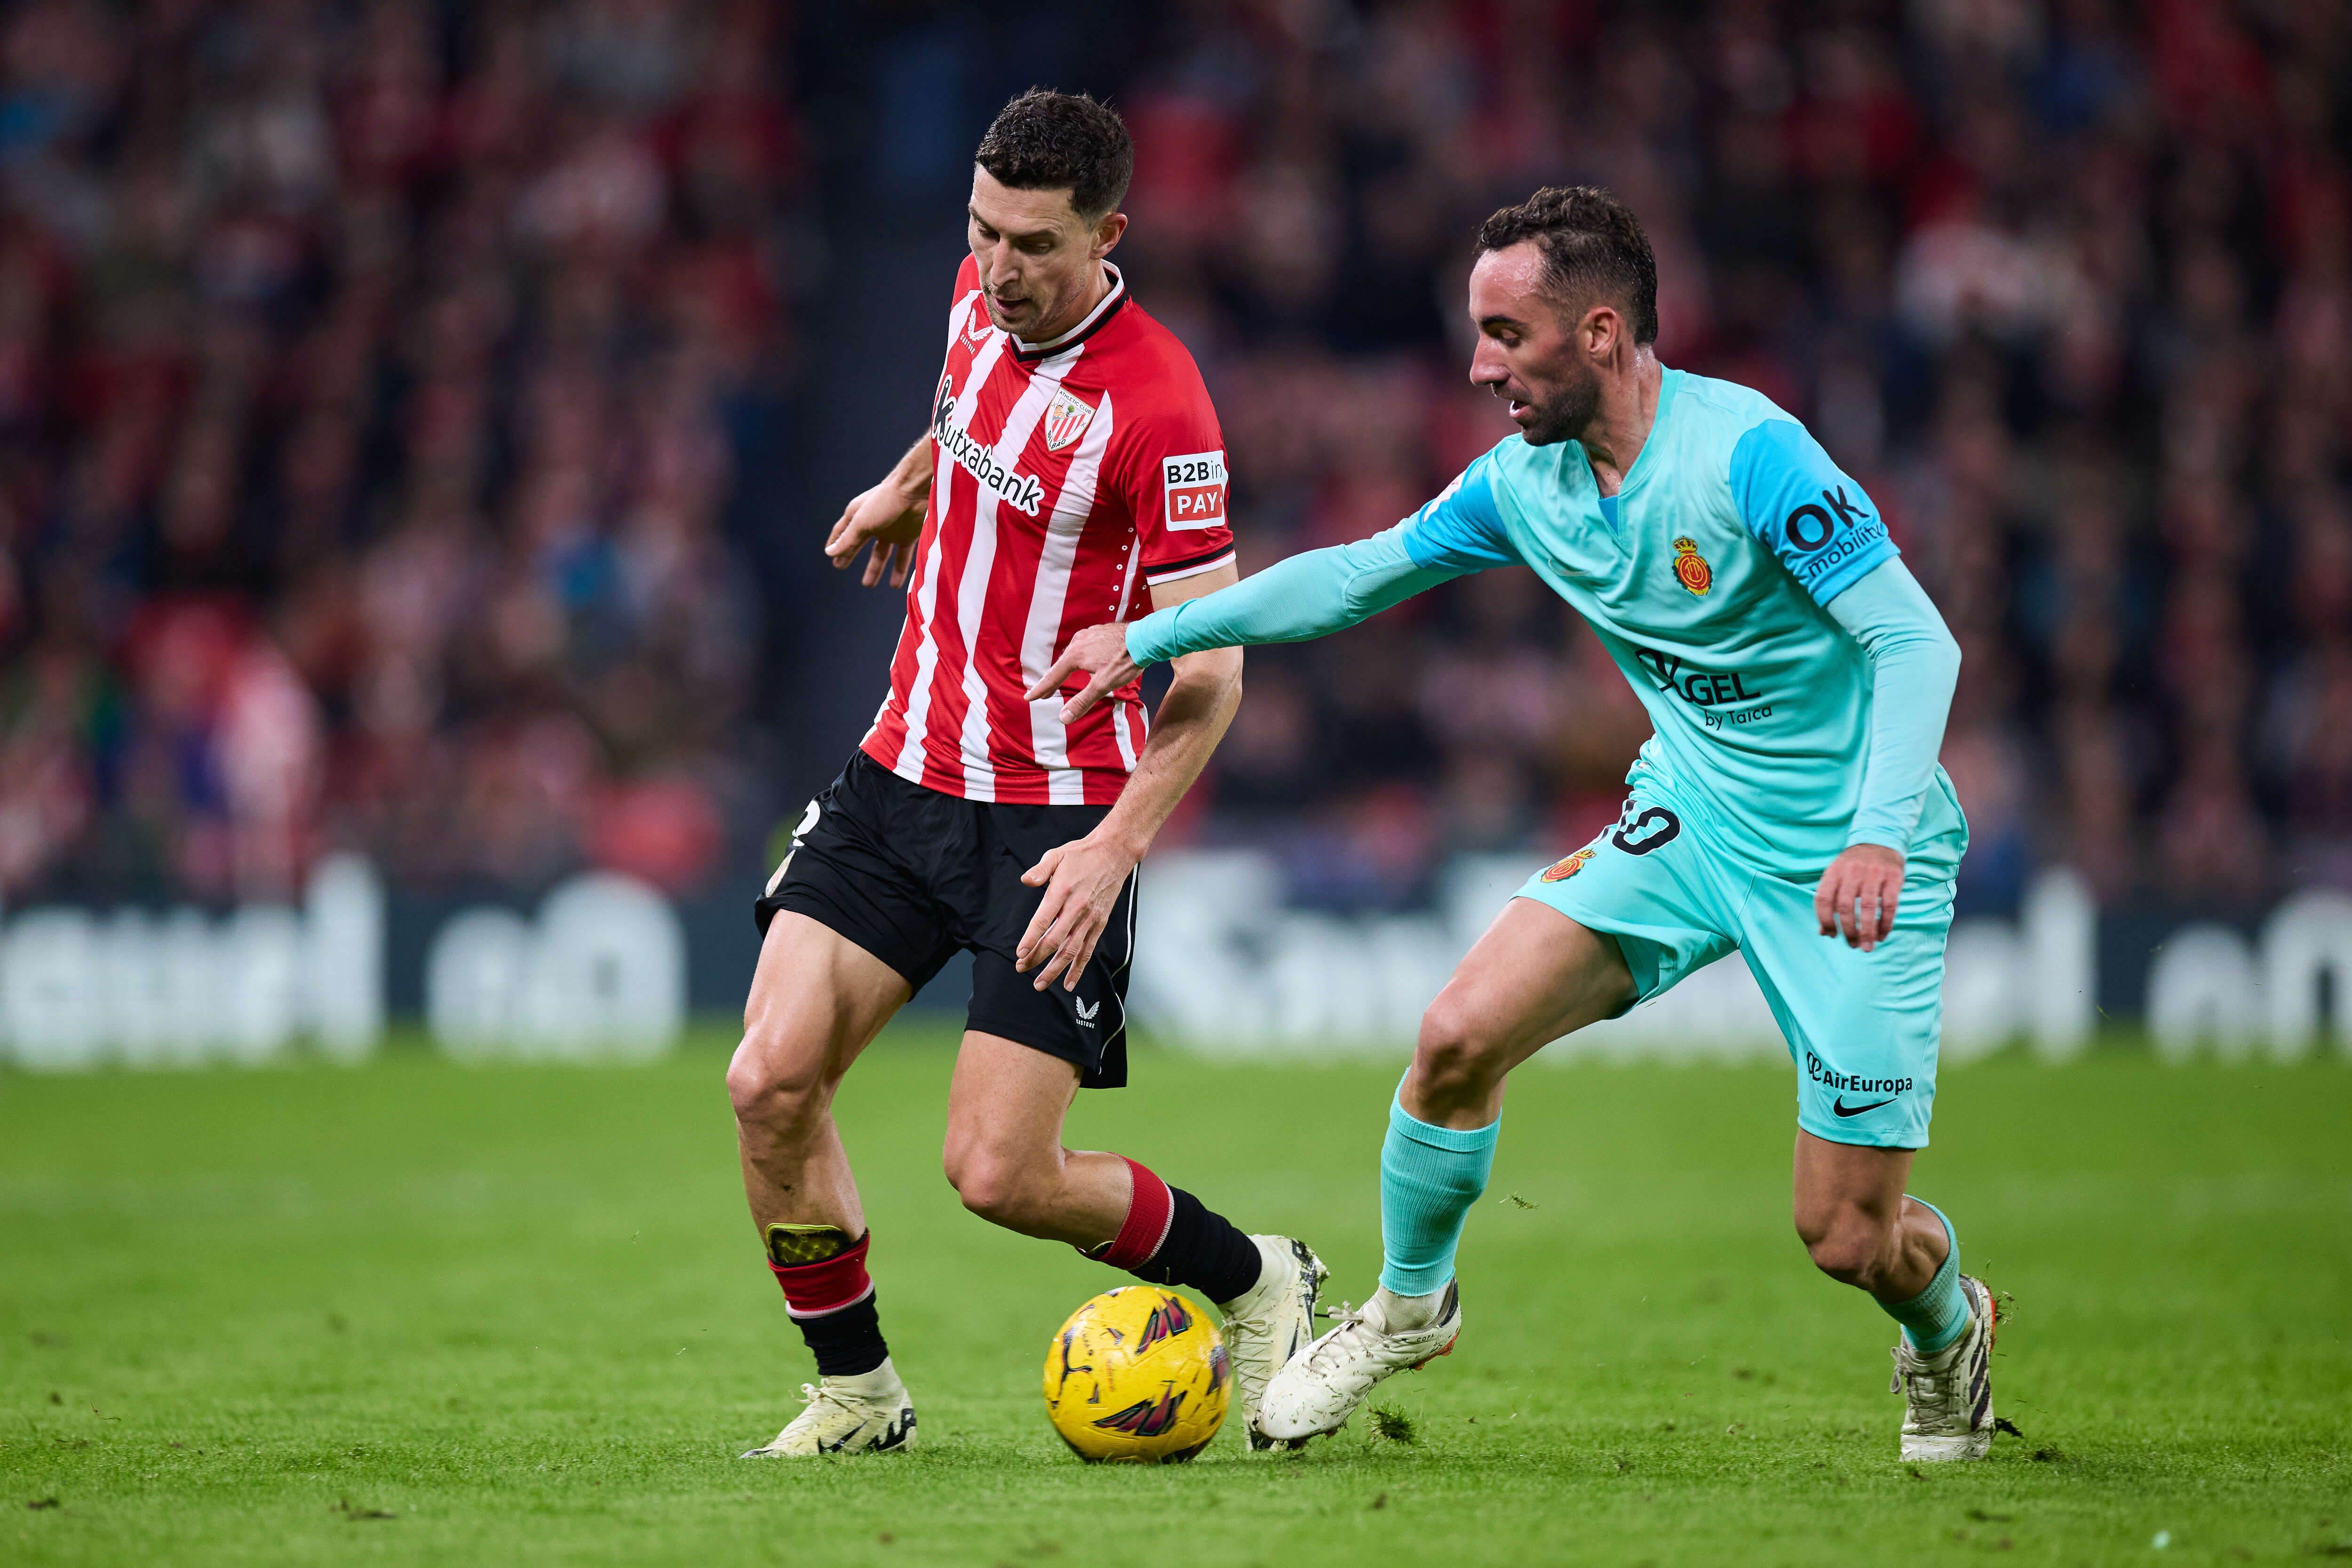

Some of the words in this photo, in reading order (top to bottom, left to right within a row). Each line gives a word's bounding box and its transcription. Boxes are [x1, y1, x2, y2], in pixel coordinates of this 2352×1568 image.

[960, 334, 975, 354] CASTORE
[1059, 391, 1079, 406] ATHLETIC
[1080, 405, 1091, 414] CLUB
[1048, 430, 1066, 449] BILBAO
[1786, 485, 1870, 551] OK
[1808, 525, 1884, 578] mobility
[1705, 710, 1723, 731] by
[1726, 707, 1772, 724] Taica
[1076, 1019, 1095, 1029] CASTORE
[1417, 1333, 1434, 1342] COPA
